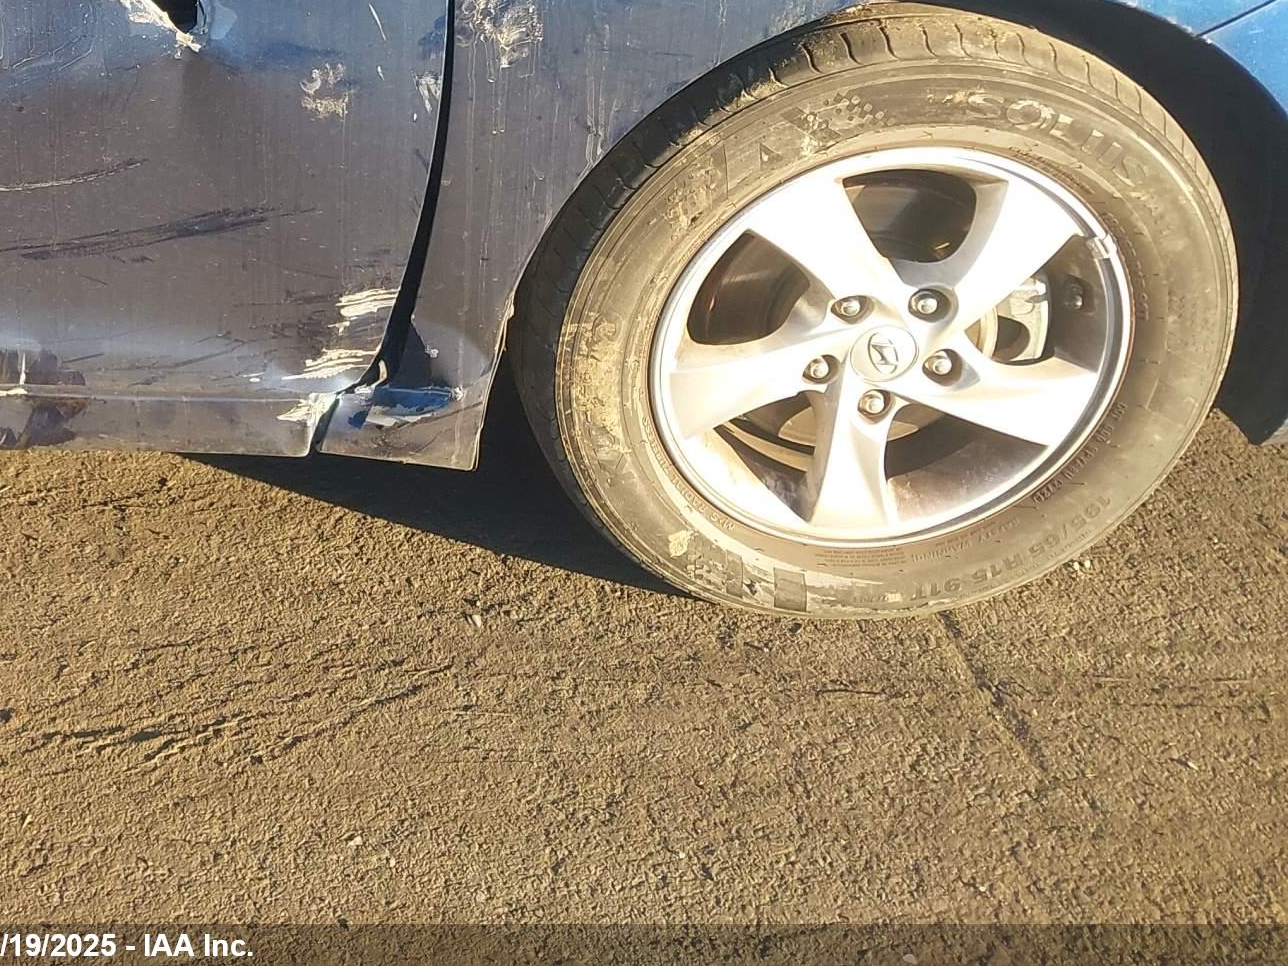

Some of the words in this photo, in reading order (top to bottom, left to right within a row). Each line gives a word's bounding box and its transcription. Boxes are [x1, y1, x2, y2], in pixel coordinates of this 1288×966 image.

[966, 94, 1146, 188] SOLUS
[1028, 495, 1112, 560] 195/65
[912, 577, 961, 600] 91T
[971, 553, 1024, 583] R15
